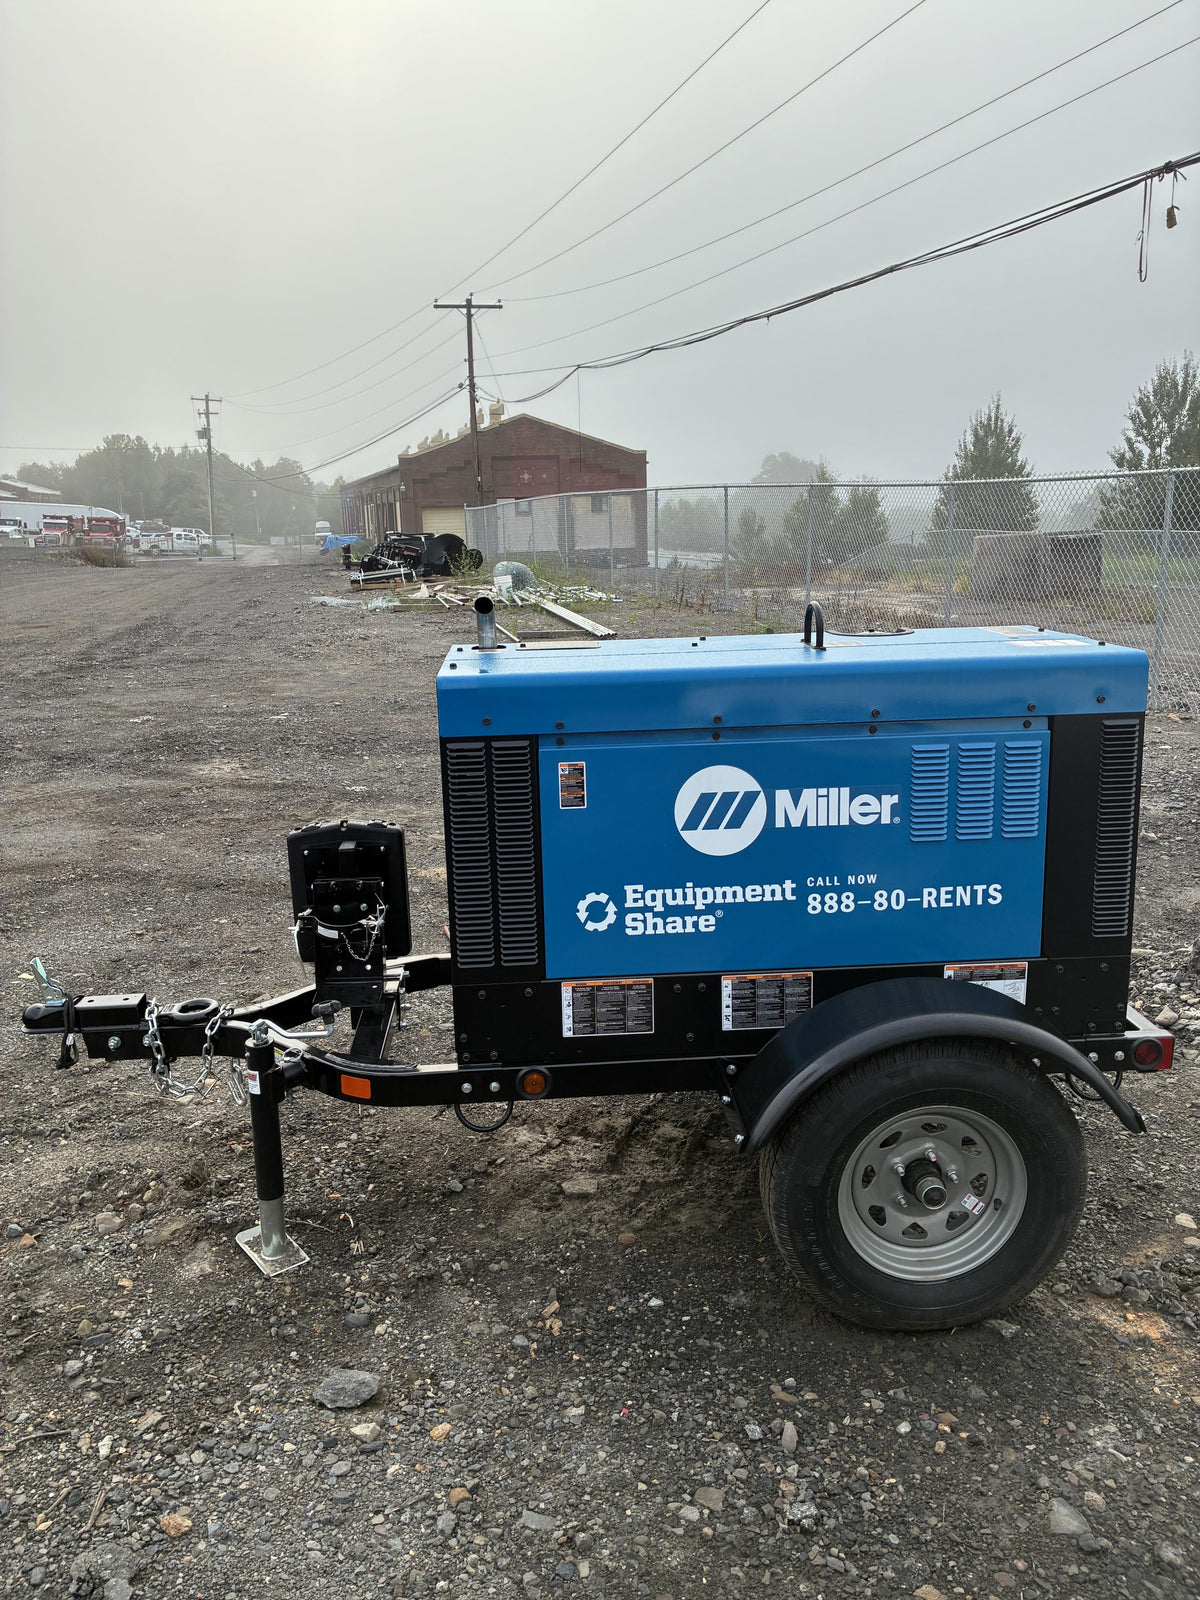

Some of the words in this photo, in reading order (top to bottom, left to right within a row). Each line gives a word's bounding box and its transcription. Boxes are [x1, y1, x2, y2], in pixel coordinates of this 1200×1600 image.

[623, 879, 797, 912] Equipment
[806, 876, 841, 887] CALL
[847, 873, 878, 885] NOW
[806, 883, 1003, 915] 888-80-RENTS
